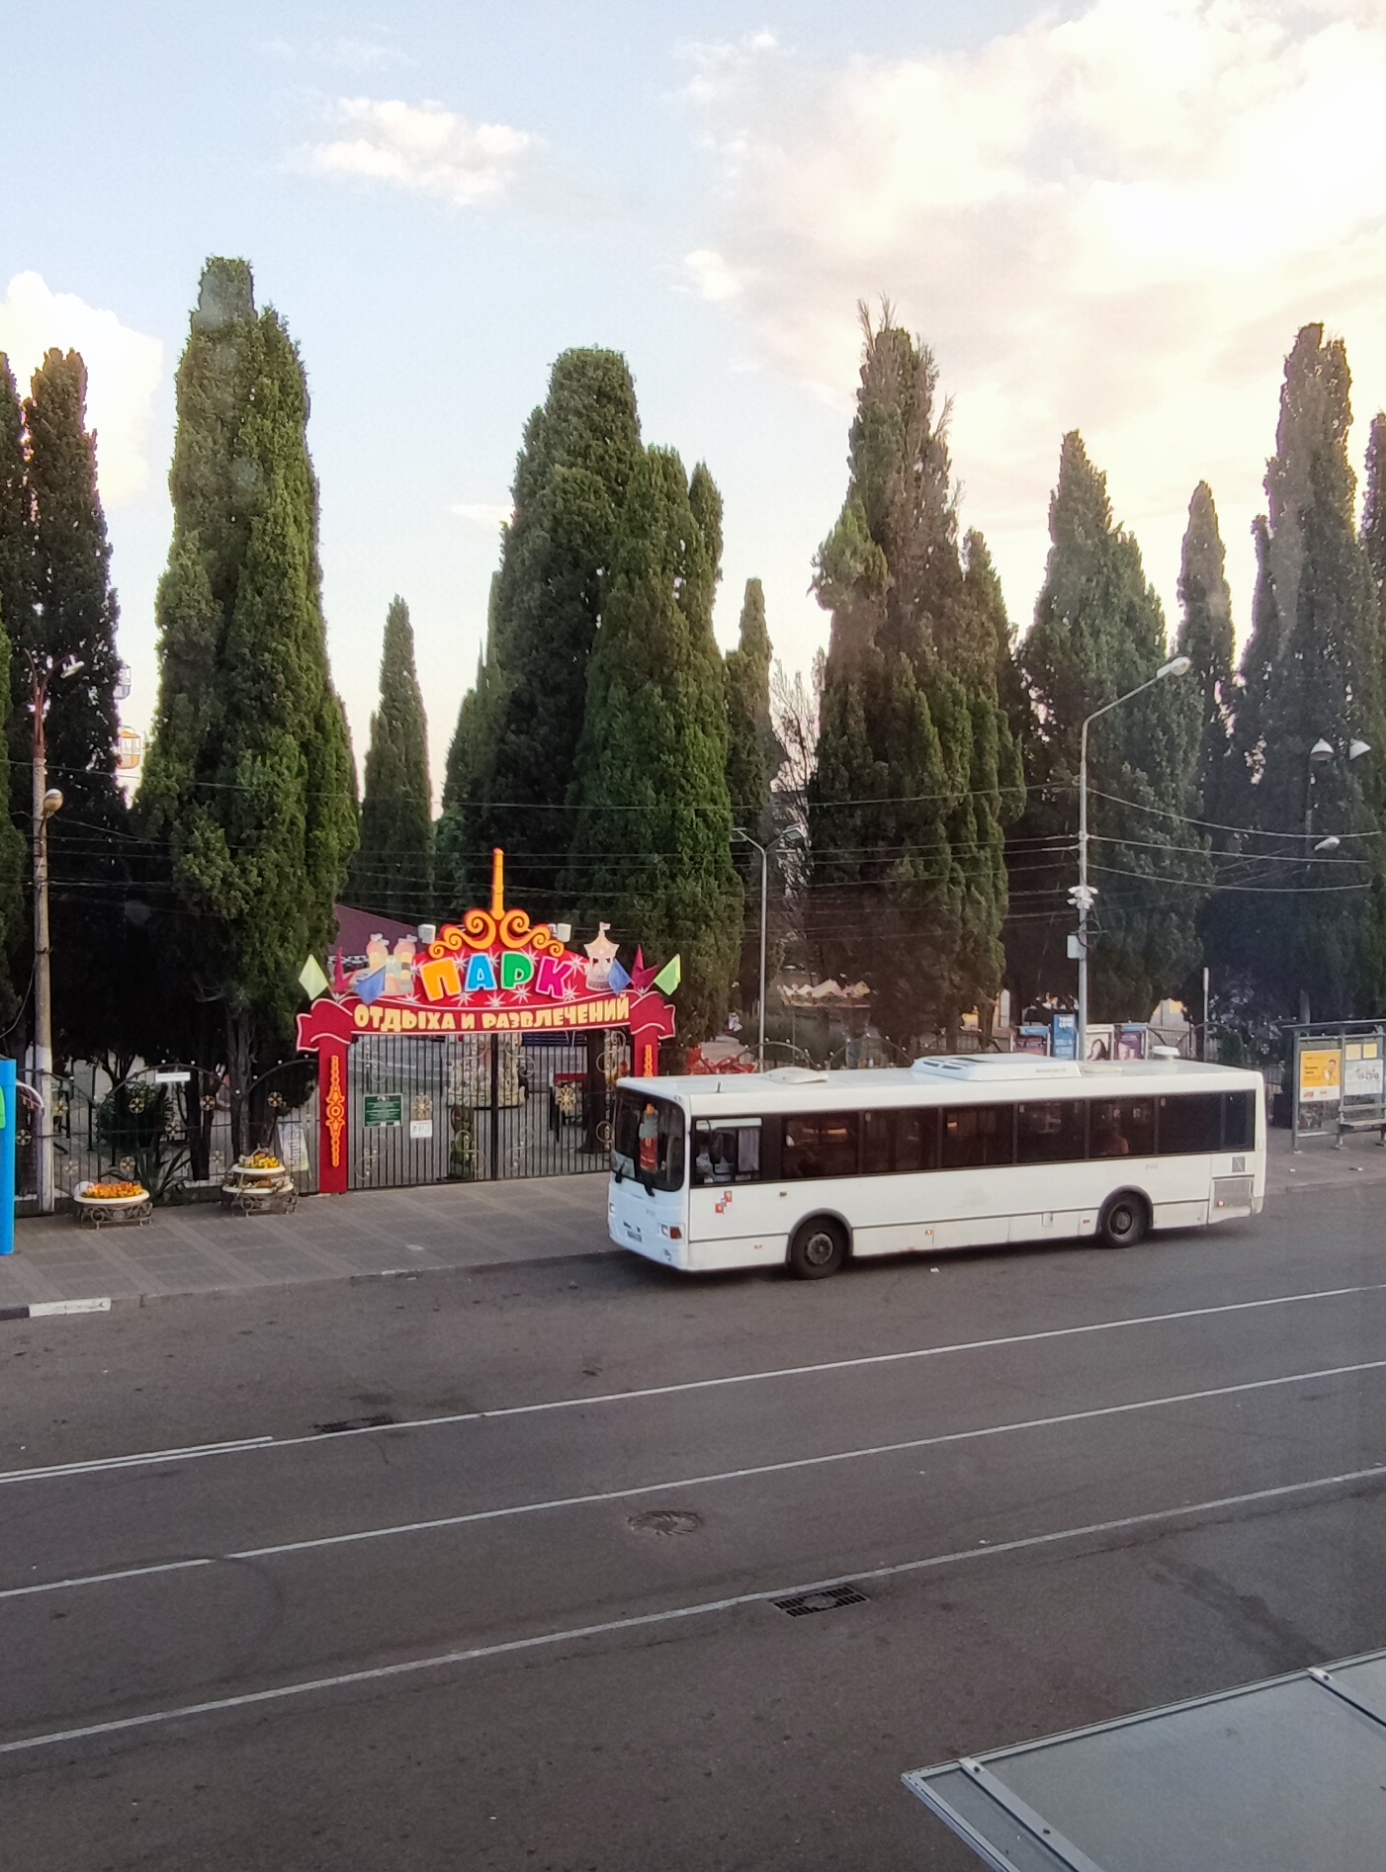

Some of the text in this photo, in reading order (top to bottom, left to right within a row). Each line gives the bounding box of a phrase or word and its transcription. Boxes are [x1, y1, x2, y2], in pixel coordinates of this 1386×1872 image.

[419, 951, 575, 1002] ПАРК
[353, 993, 630, 1032] ОТДЫХА И РАЗВЛЕЧЕНИЙ
